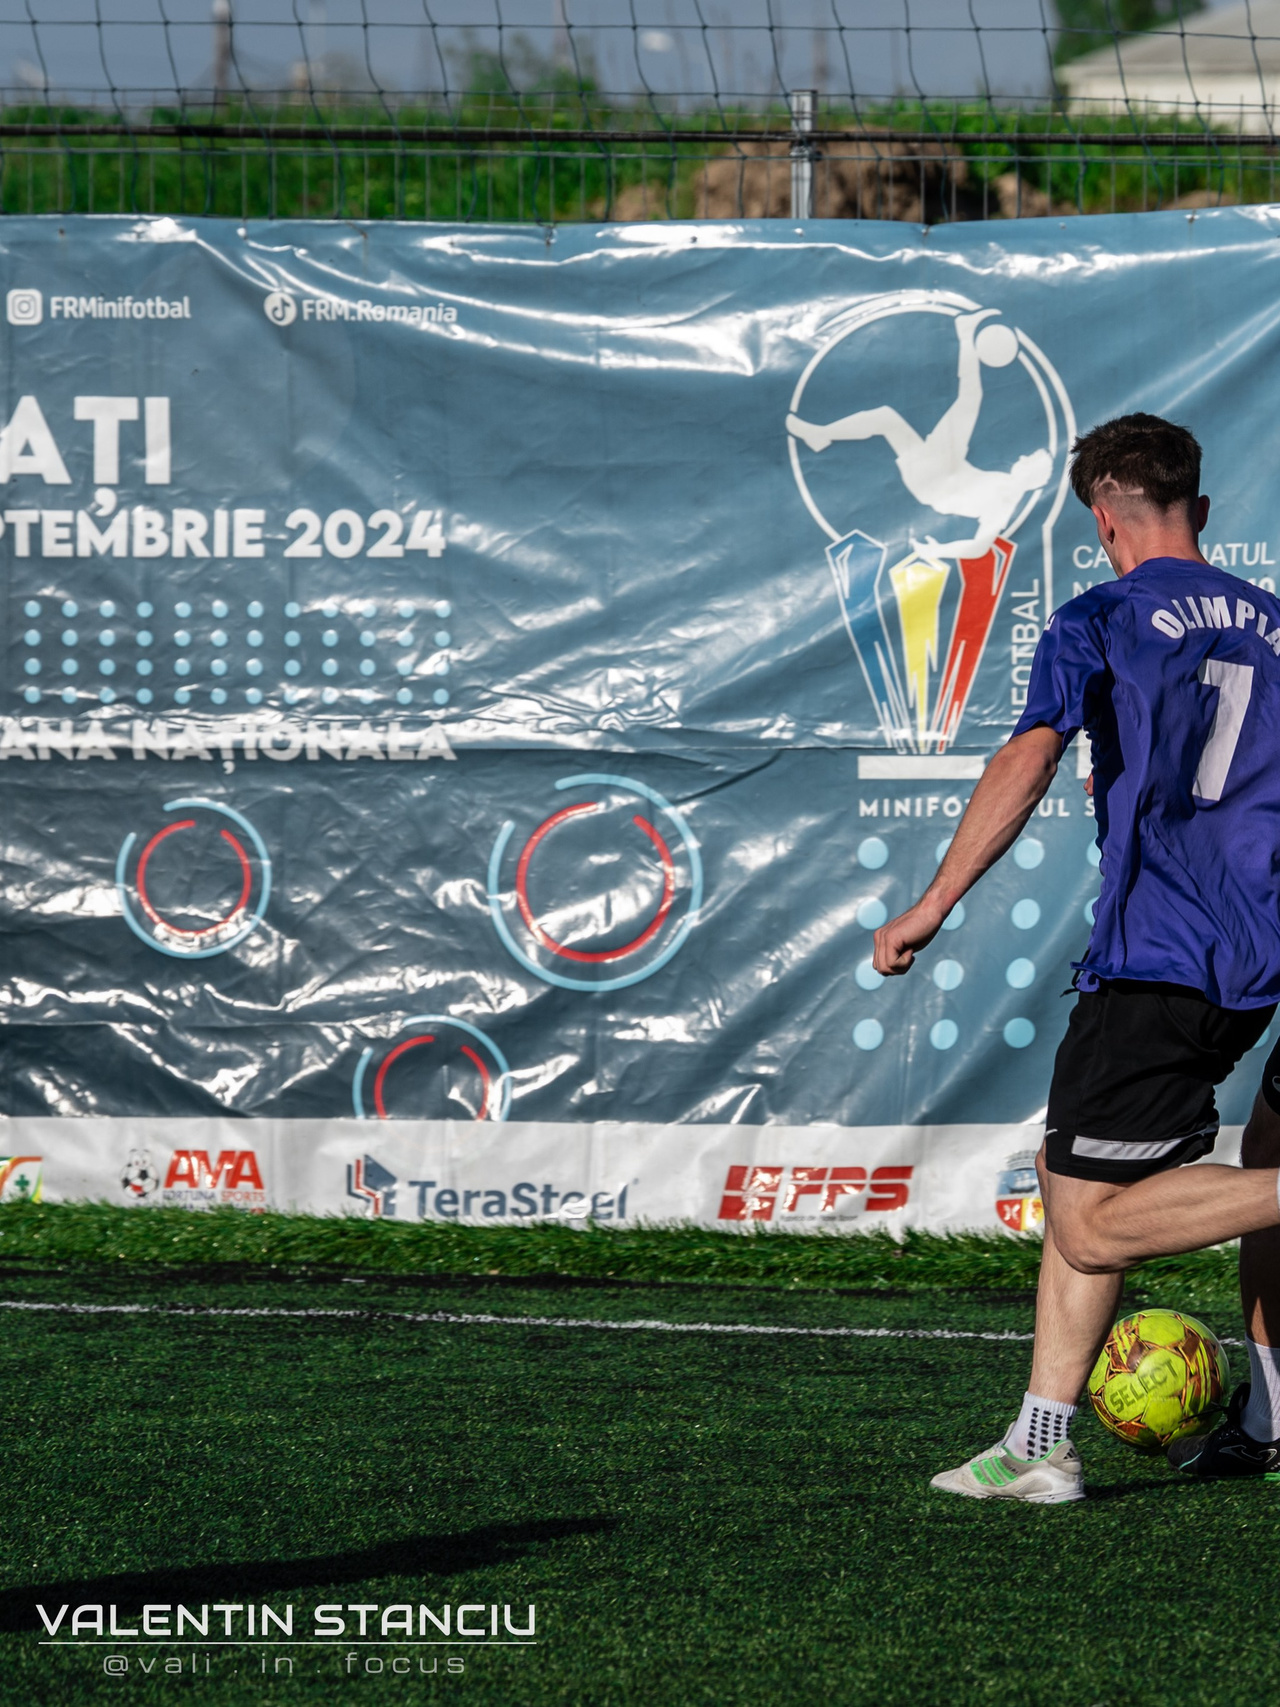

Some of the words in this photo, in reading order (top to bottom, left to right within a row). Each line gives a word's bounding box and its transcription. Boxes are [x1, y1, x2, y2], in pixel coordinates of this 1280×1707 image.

[50, 297, 191, 319] FRMinifotbal
[302, 300, 458, 323] FRM.Romania
[0, 509, 266, 558] TEMBRIE
[284, 508, 446, 559] 2024
[1072, 542, 1276, 569] CAATUL
[1192, 658, 1254, 801] 7
[221, 1191, 265, 1202] SPORTS
[409, 1172, 628, 1219] TeraSteel
[1110, 1358, 1178, 1414] SELECT
